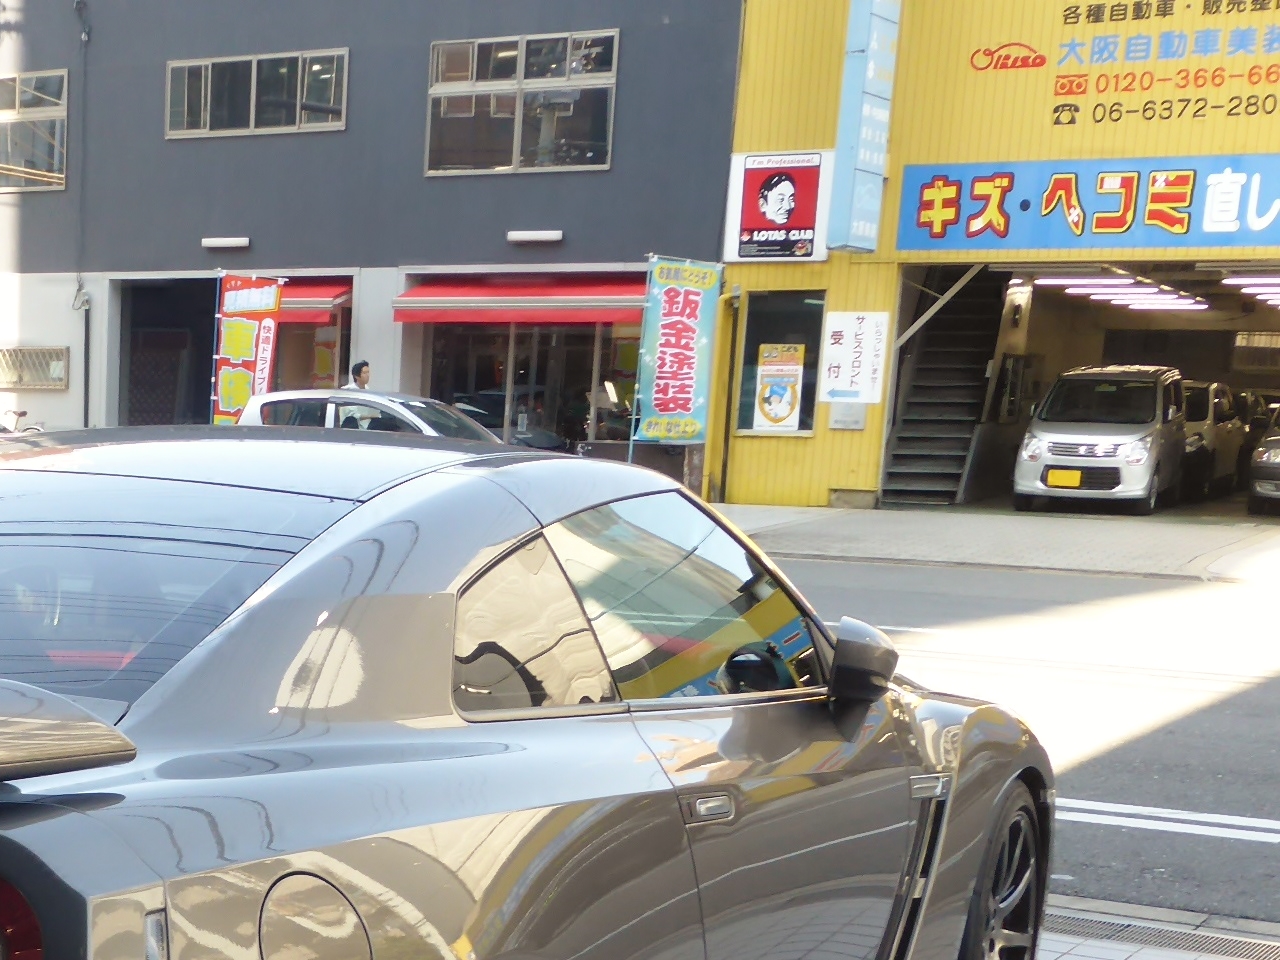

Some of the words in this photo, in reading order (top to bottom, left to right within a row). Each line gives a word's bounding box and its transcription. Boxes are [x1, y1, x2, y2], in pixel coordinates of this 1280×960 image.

[752, 230, 787, 241] LOTAS
[788, 229, 814, 240] CLUB
[653, 286, 703, 414] 鈑金塗装
[850, 315, 866, 388] サービスフロント
